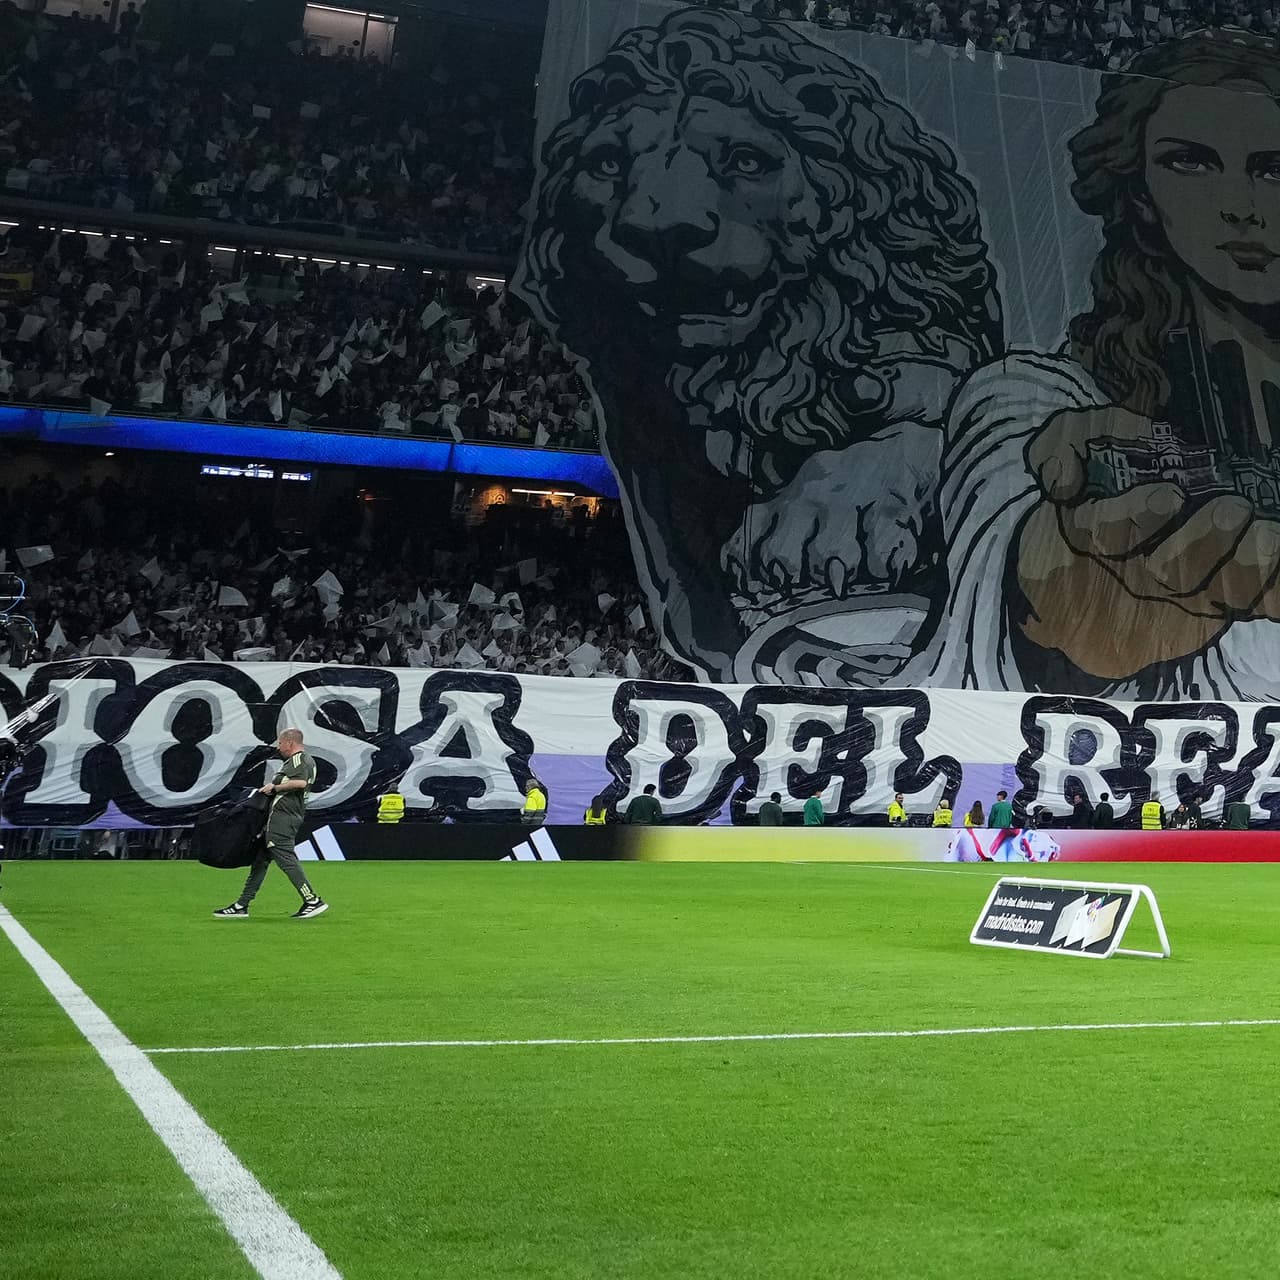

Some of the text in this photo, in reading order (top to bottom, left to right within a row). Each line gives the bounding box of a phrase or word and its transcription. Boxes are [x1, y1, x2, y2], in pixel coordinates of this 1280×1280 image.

[0, 658, 537, 826] IOSA
[606, 681, 962, 827] DEL
[984, 913, 1044, 934] madridistas.com
